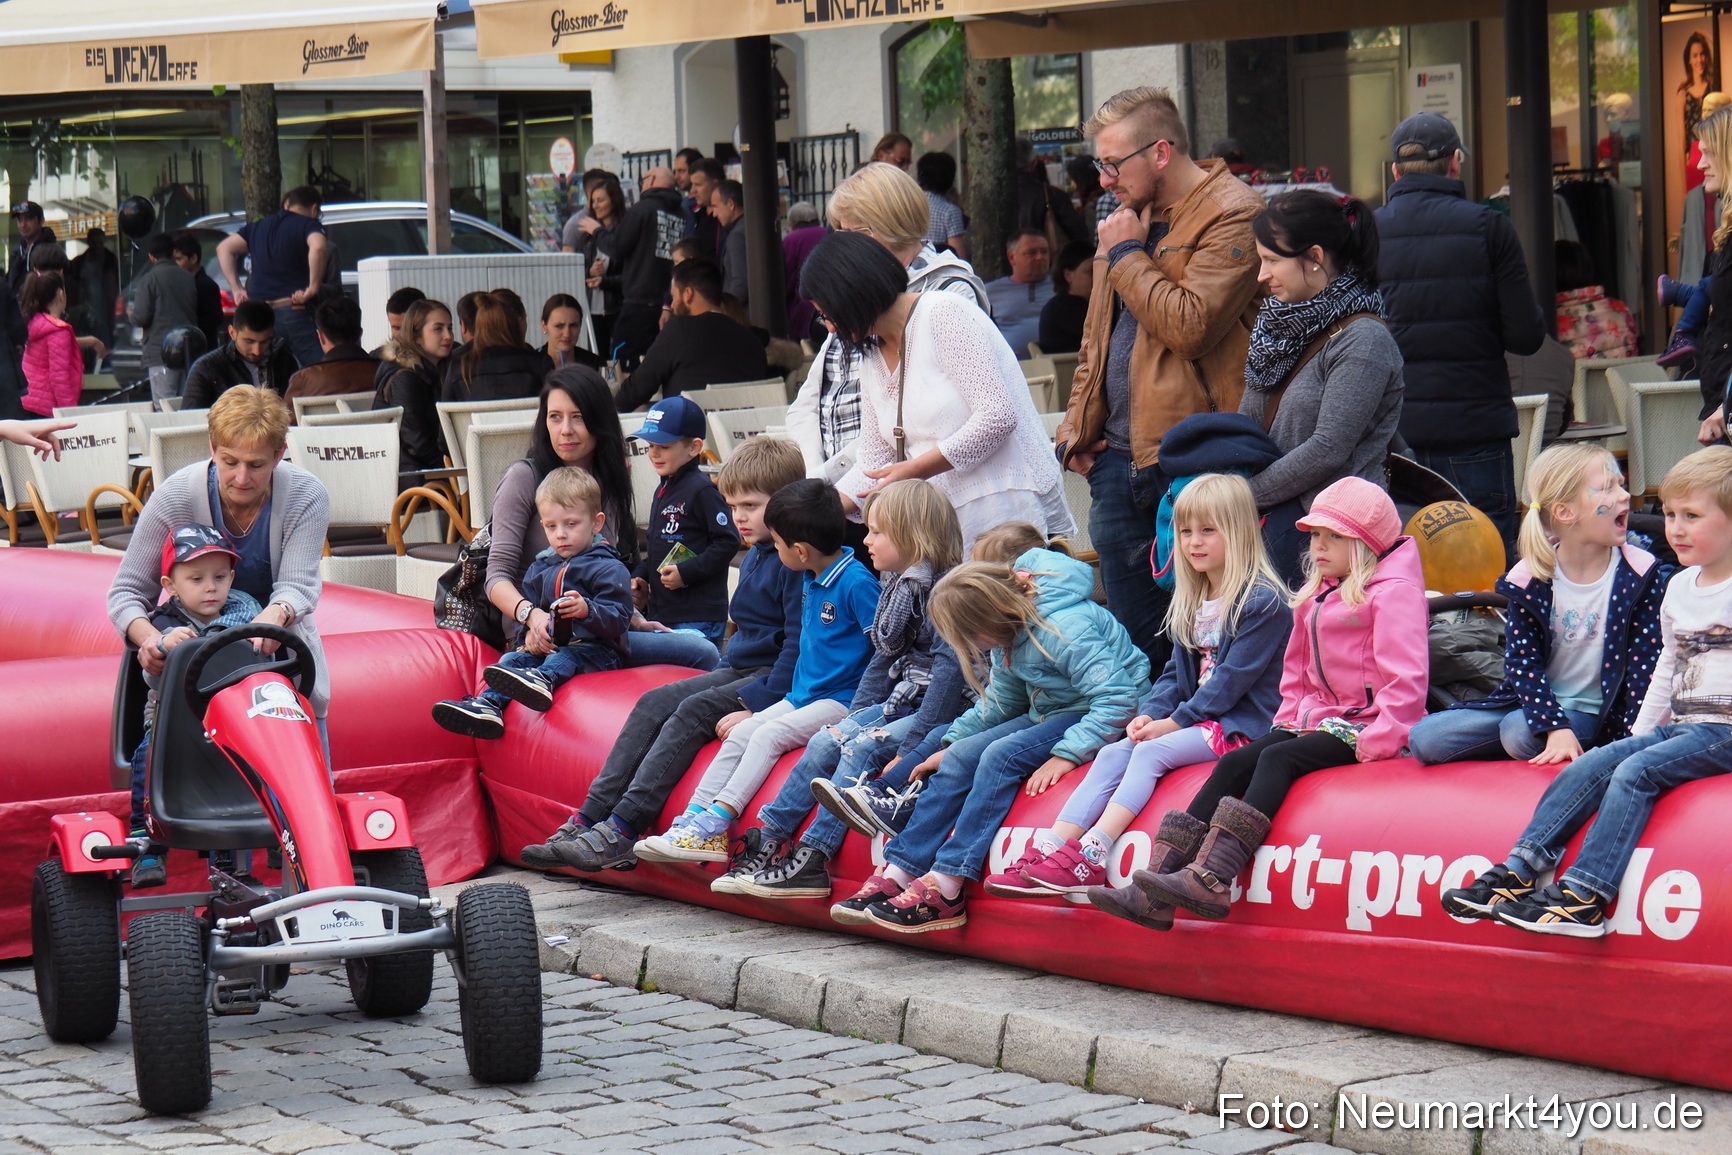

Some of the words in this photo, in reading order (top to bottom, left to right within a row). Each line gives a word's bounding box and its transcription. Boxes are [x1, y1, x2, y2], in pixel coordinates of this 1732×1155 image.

[551, 2, 628, 47] Glossner-Bier
[85, 48, 104, 67] EIS
[104, 45, 167, 83] LORENZO
[168, 62, 198, 81] CAFE
[302, 33, 369, 75] Glossner-Bier
[59, 435, 96, 451] ORENZO
[319, 446, 364, 461] LORENZO
[364, 450, 387, 460] CAFE
[1415, 503, 1465, 531] KBK
[1074, 863, 1090, 882] 62
[320, 921, 343, 931] DINO
[343, 920, 365, 928] CARS
